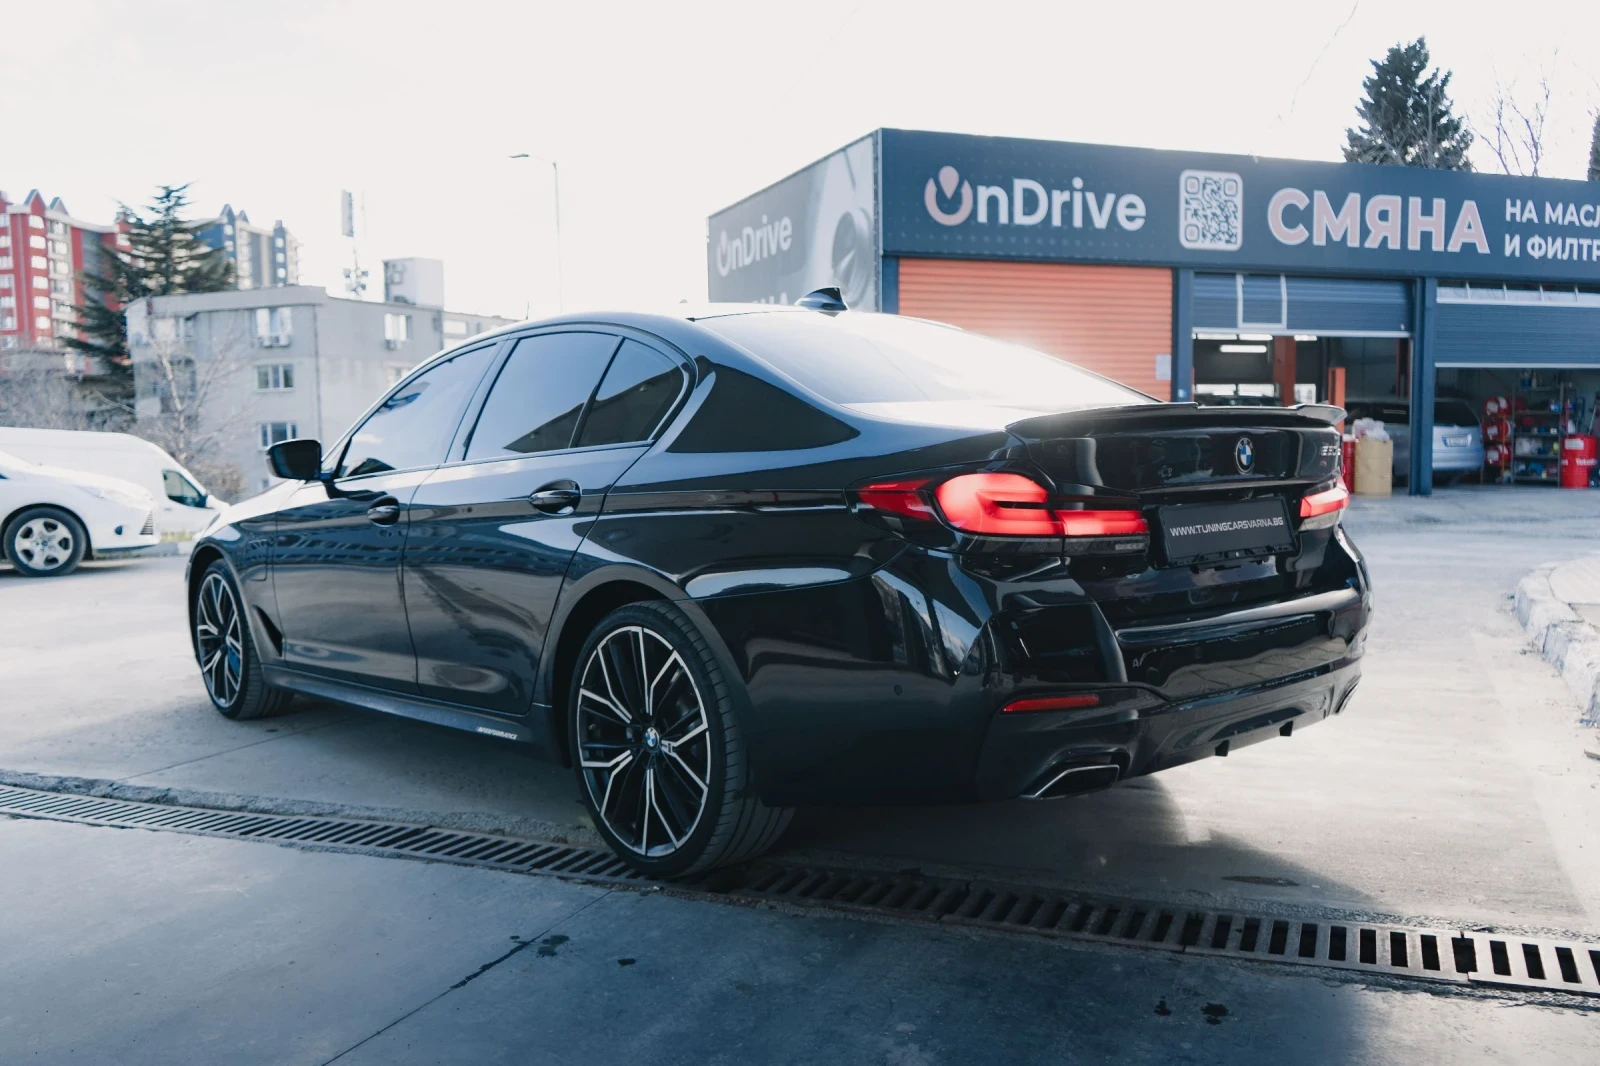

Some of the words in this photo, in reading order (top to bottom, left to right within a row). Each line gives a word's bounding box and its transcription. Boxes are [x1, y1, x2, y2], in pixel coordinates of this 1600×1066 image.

[924, 165, 1147, 231] OnDrive
[1267, 187, 1491, 254] СМЯНА
[1505, 198, 1539, 224] НА
[717, 213, 793, 278] OnDrive
[1504, 233, 1520, 258] И
[1526, 234, 1600, 262] ФИЛТР
[1169, 516, 1284, 537] WWW.TUNINGCARSVARNA.BG
